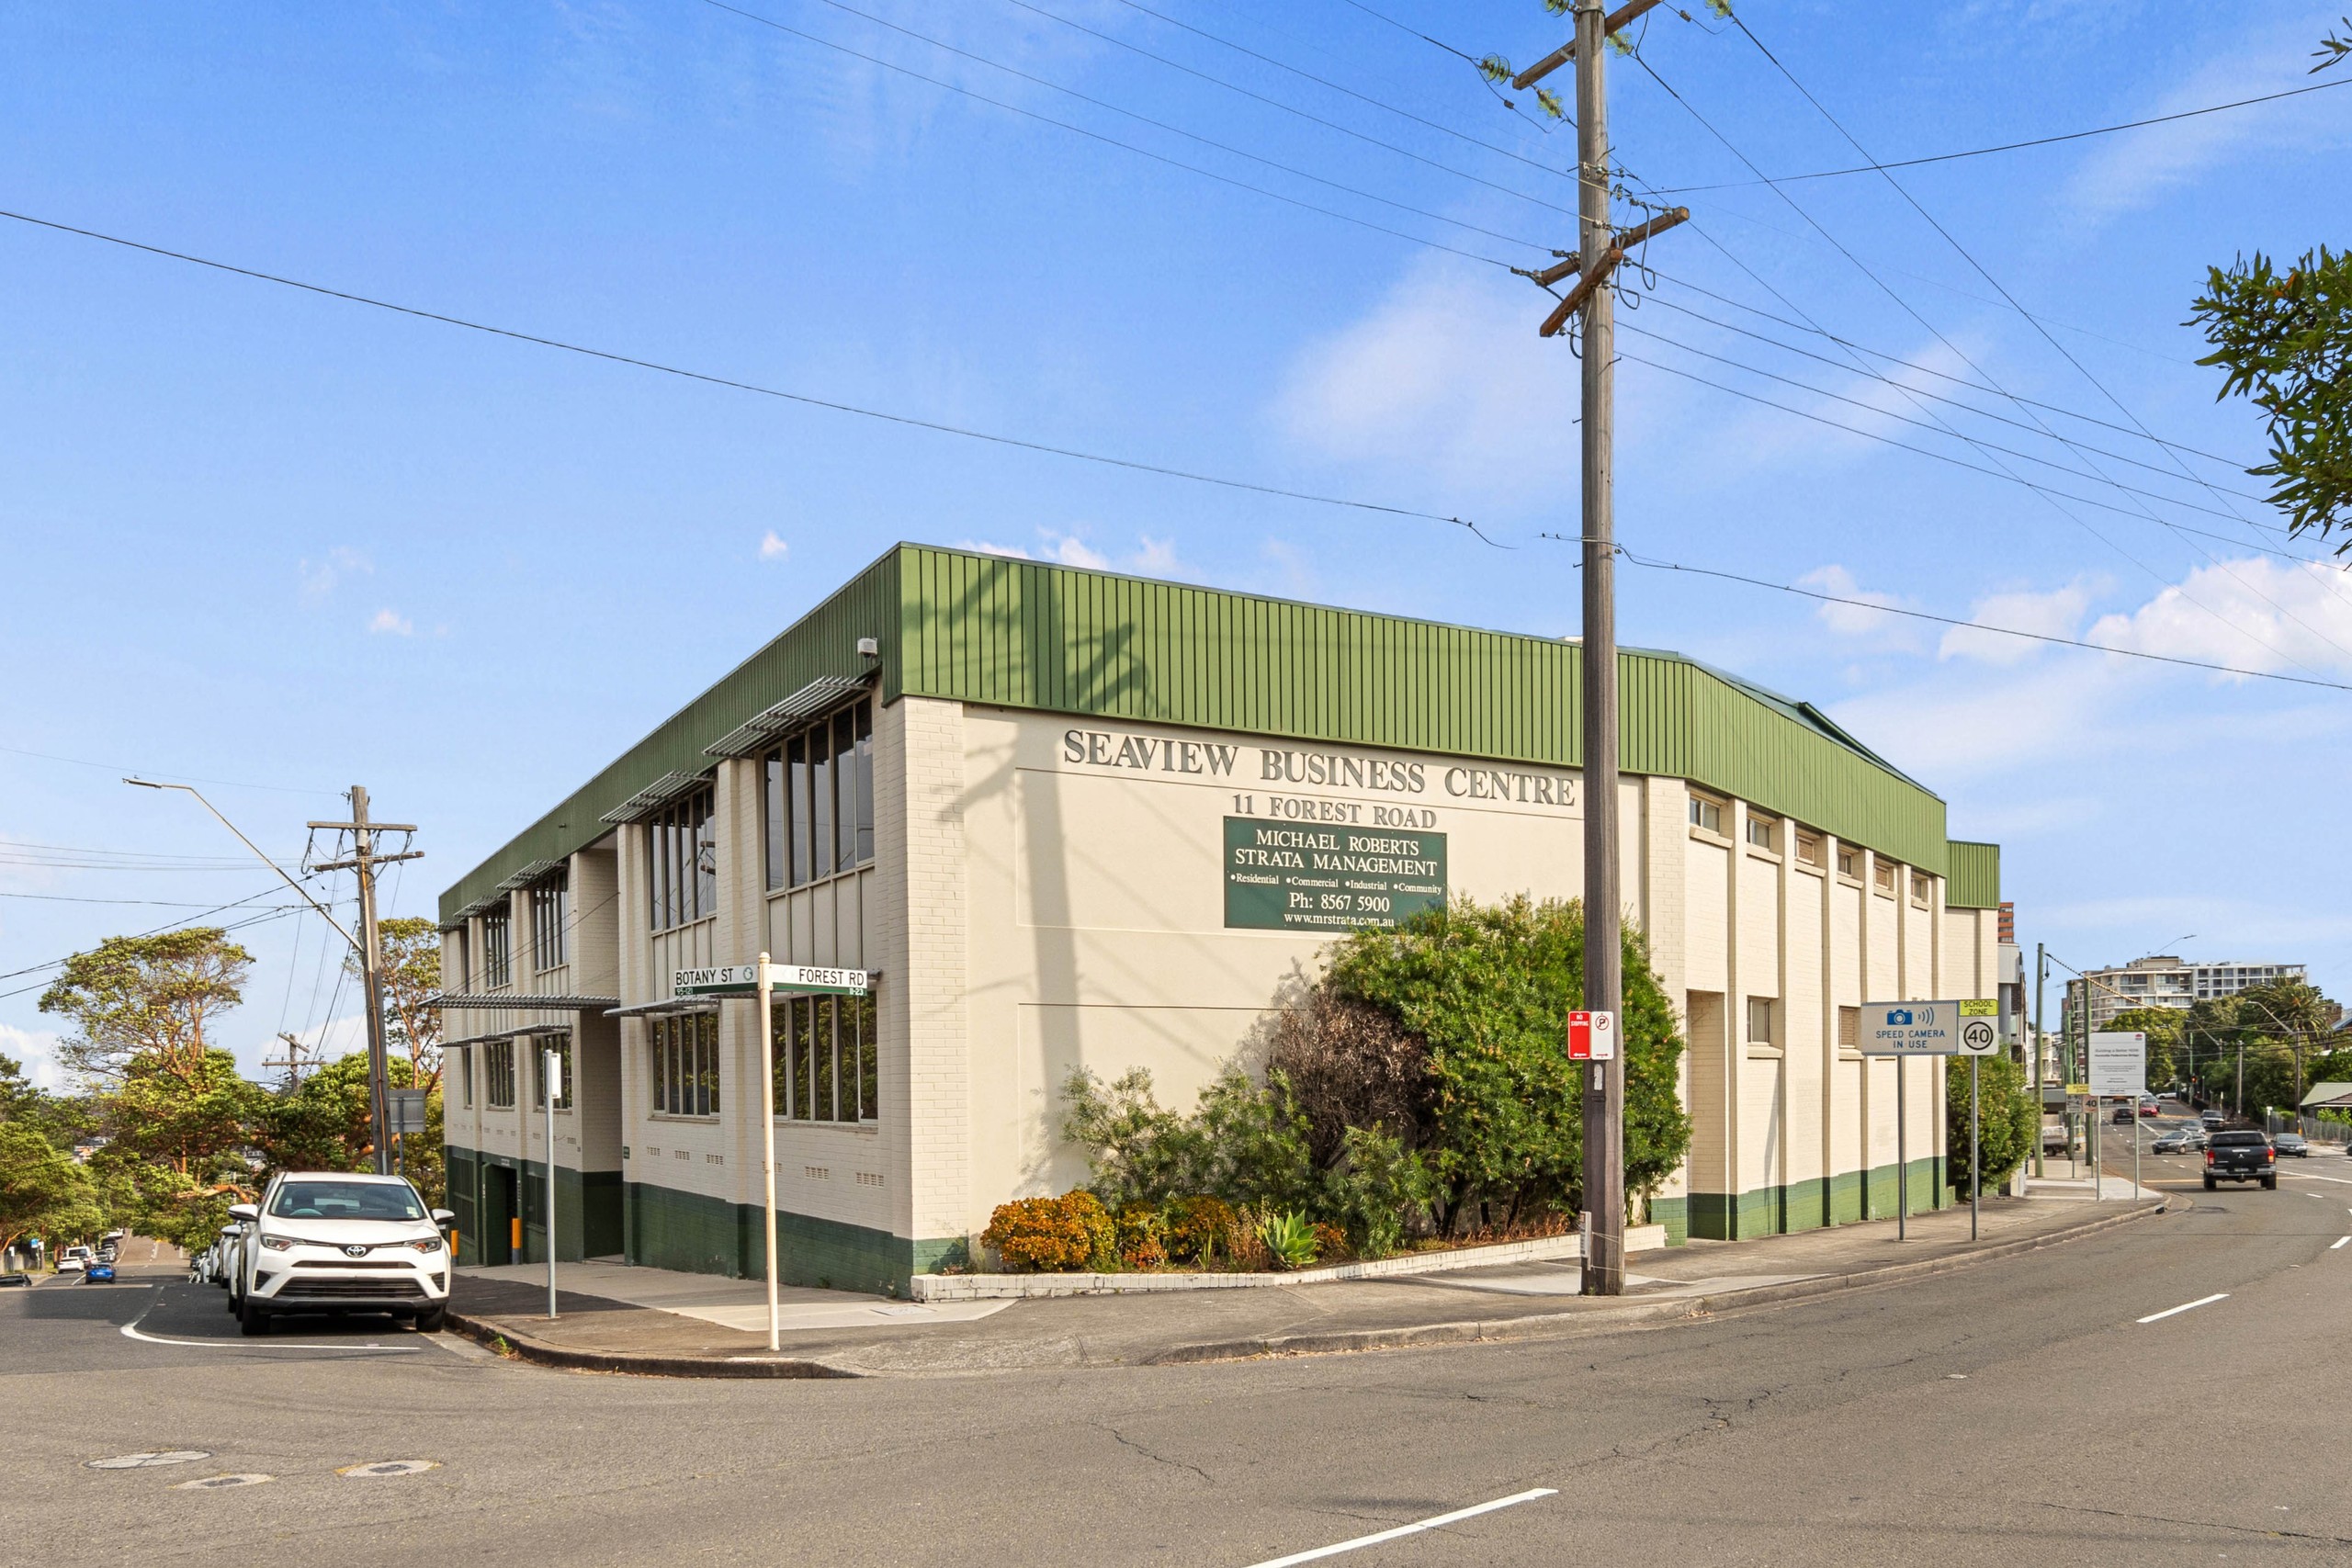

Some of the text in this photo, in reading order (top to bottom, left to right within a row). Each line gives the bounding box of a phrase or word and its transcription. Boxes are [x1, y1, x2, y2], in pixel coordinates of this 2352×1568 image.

[1063, 728, 1577, 807] SEAVIEW BUSINESS CENTRE
[1232, 793, 1437, 829] 11 FOREST ROAD
[1256, 829, 1419, 856] MICHAEL ROBERTS
[1235, 848, 1437, 876] STRATA MANAGEMENT
[1236, 872, 1442, 897] Residential Commercial Industrial Community
[1289, 892, 1390, 912] Ph: 8567 5900
[1283, 911, 1395, 928] www.mrstrata.com.au
[675, 967, 734, 986] BOTANY ST
[798, 968, 865, 987] FOREST RD
[1963, 1000, 1993, 1009] SCHOOL
[1968, 1008, 1988, 1016] ZONE
[1875, 1030, 1945, 1039] SPEED CAMERA
[1967, 1029, 1990, 1043] 40
[1893, 1040, 1928, 1049] IN USE
